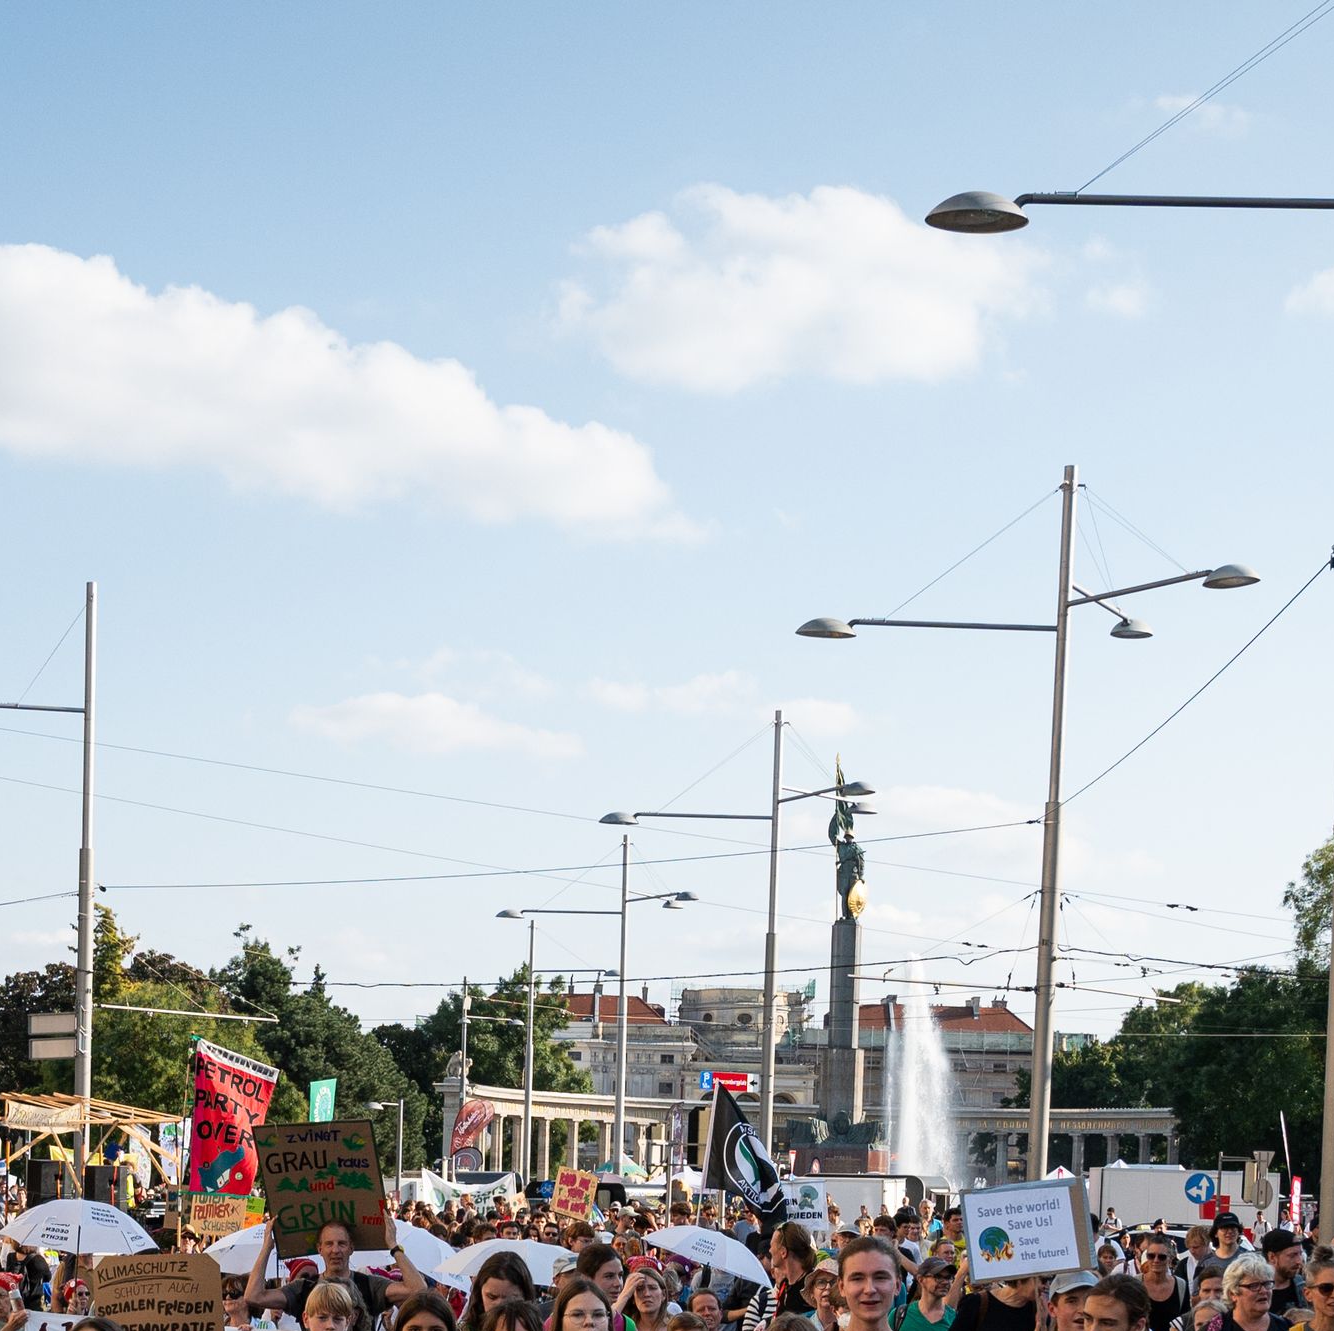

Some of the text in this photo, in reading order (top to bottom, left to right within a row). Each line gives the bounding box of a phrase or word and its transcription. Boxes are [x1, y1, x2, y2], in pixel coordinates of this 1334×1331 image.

[195, 1056, 264, 1103] PETROL
[194, 1089, 259, 1125] PARTY
[196, 1119, 254, 1149] OVER
[266, 1149, 370, 1174] GRAU raus
[309, 1176, 335, 1191] und
[91, 1211, 115, 1219] GEGEN
[276, 1197, 357, 1231] GRÜN
[977, 1198, 1060, 1218] Save the world!
[91, 1216, 119, 1224] RECHTS
[1007, 1215, 1053, 1231] Save Us!
[691, 1245, 714, 1257] RECHTS
[695, 1241, 716, 1252] GEGEN
[1018, 1236, 1040, 1247] Save
[1020, 1246, 1069, 1261] the future!
[97, 1261, 189, 1284] KLIMASCHUTZ
[114, 1281, 200, 1300] SCHÜTZT AUCH
[97, 1298, 215, 1318] SOZIALEN FRIEDEN
